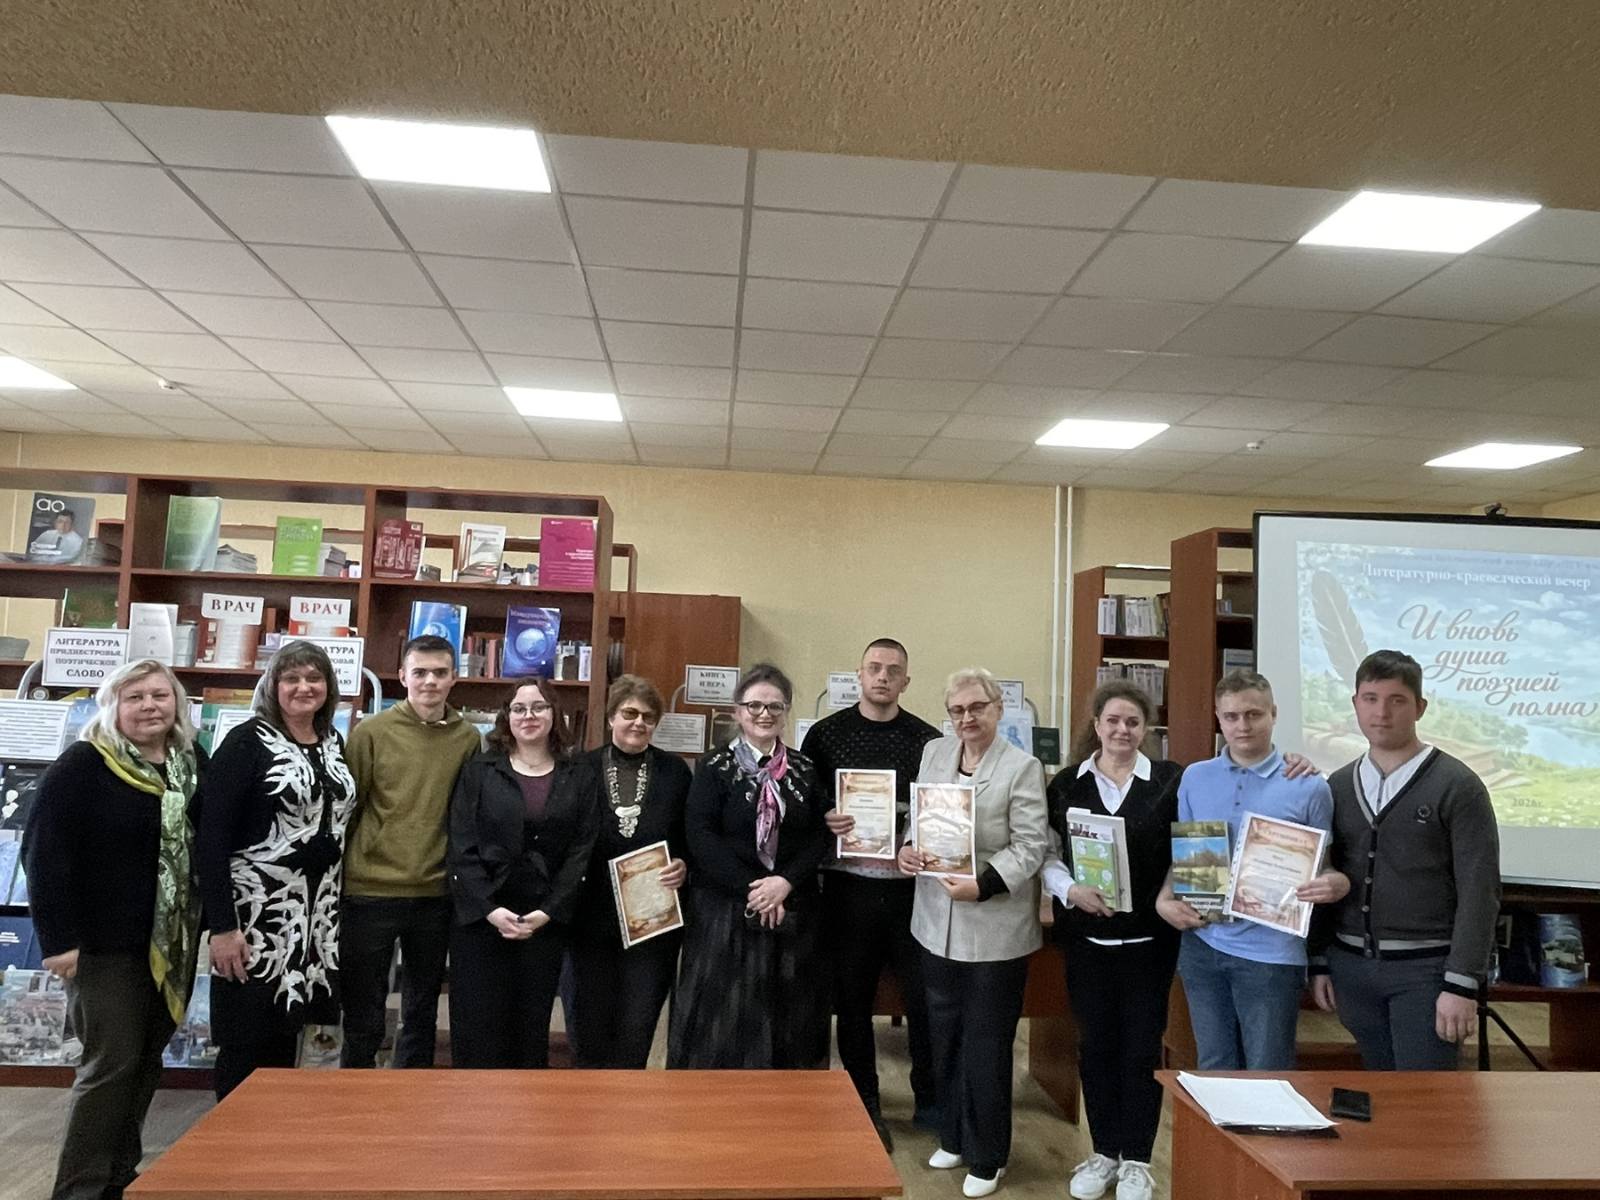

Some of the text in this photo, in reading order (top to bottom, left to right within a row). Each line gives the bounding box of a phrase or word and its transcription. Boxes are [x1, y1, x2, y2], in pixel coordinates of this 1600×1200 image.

[1362, 562, 1592, 591] Литературно-краеведческий вечер
[211, 599, 256, 613] ВРАЧ
[300, 602, 343, 615] ВРАЧ
[1397, 604, 1520, 642] И вновь
[55, 638, 120, 647] ЛИТЕРАТУРА
[55, 658, 117, 666] ПОЭТИЧЕСКОЕ
[1423, 649, 1510, 683] душа
[66, 669, 105, 678] СЛОВО
[1456, 672, 1561, 706] поэзией
[1507, 701, 1598, 718] полна
